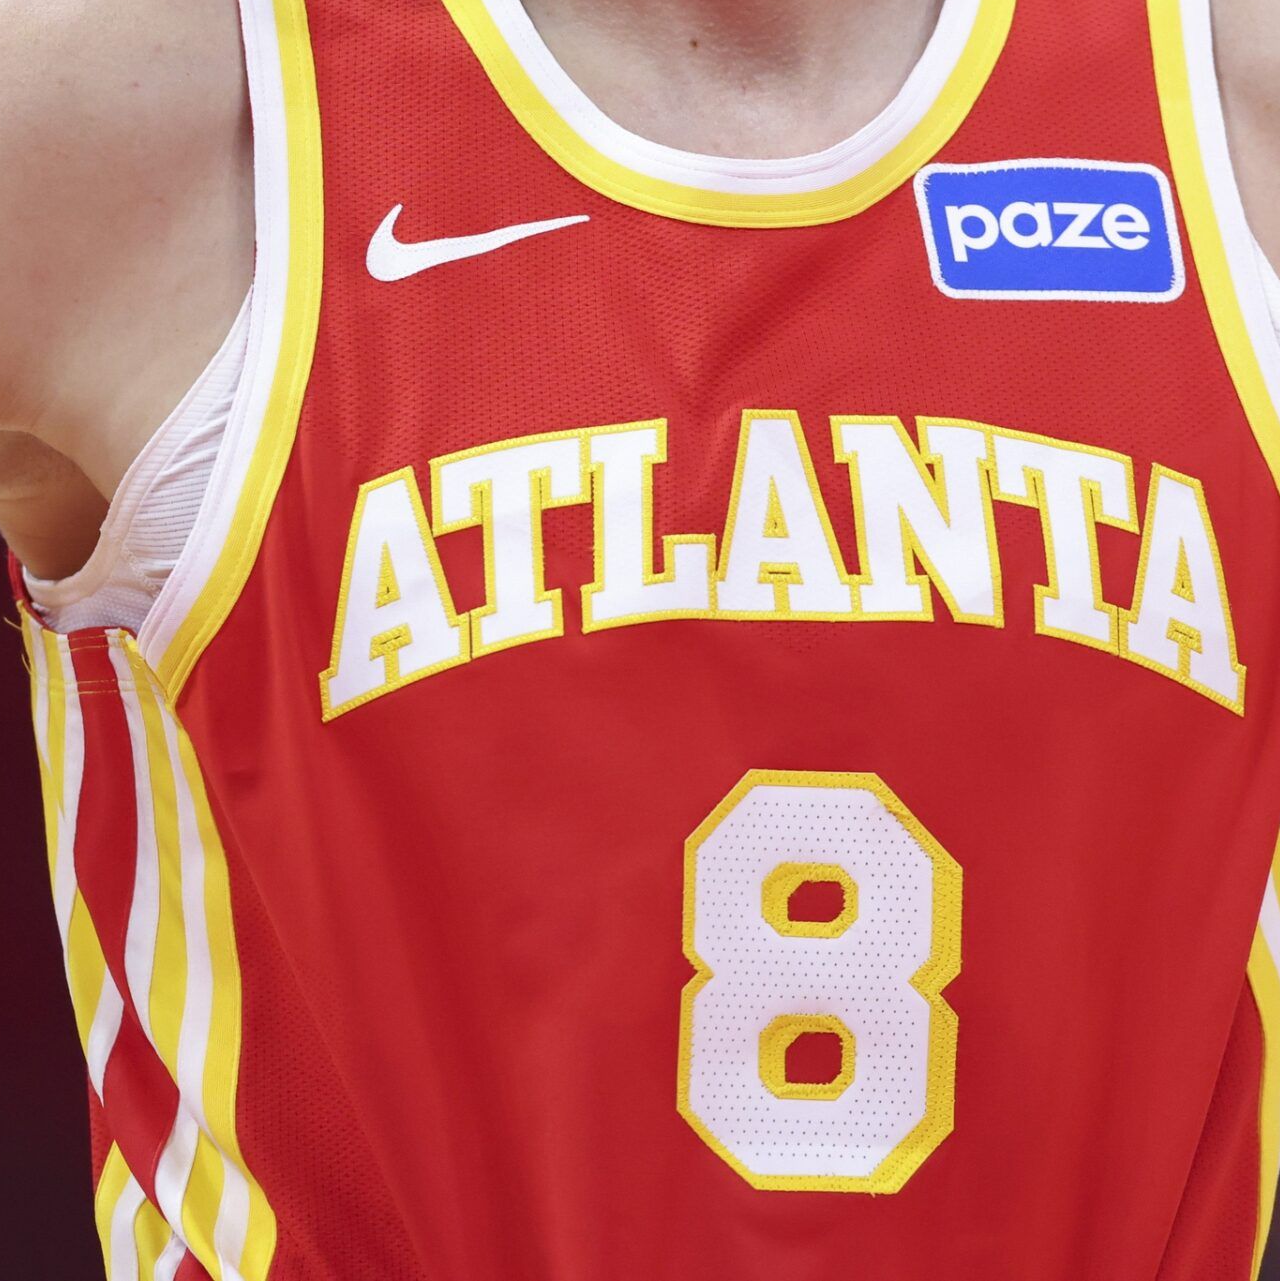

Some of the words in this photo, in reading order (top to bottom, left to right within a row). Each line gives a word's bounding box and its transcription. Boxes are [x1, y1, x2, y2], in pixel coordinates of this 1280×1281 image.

[944, 201, 1151, 262] paze
[319, 408, 1247, 723] ATLANTA
[676, 768, 963, 1195] 8
